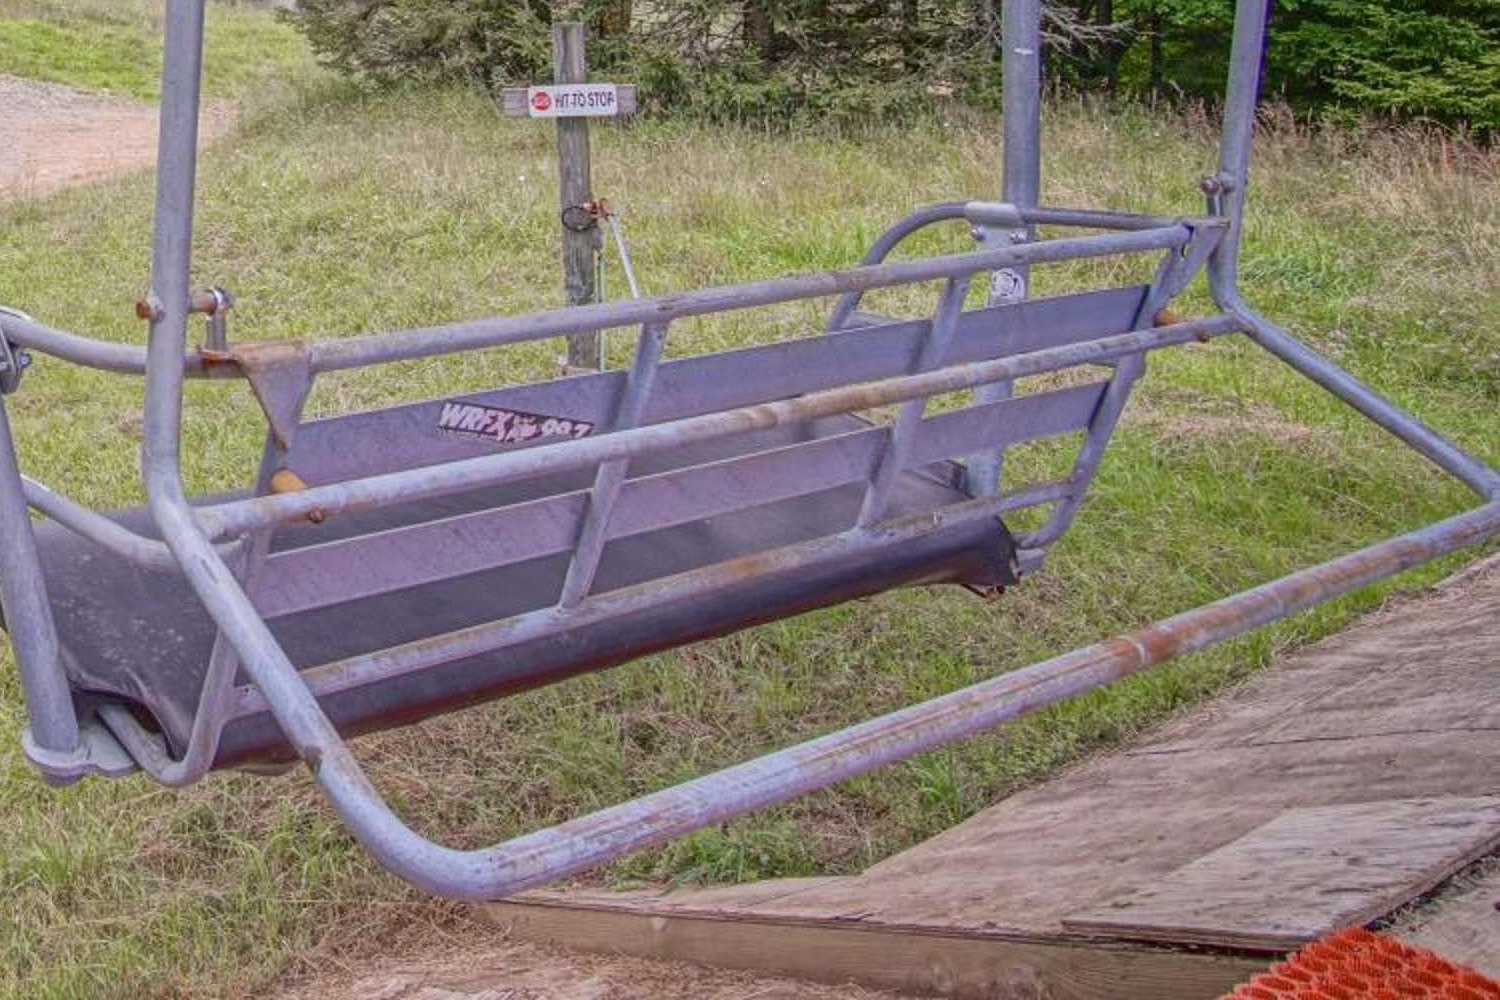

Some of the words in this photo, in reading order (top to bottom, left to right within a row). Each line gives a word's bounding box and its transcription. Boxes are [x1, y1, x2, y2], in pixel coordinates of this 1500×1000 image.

[587, 91, 615, 107] STOP
[438, 402, 515, 441] WRFX
[541, 418, 592, 440] 997
